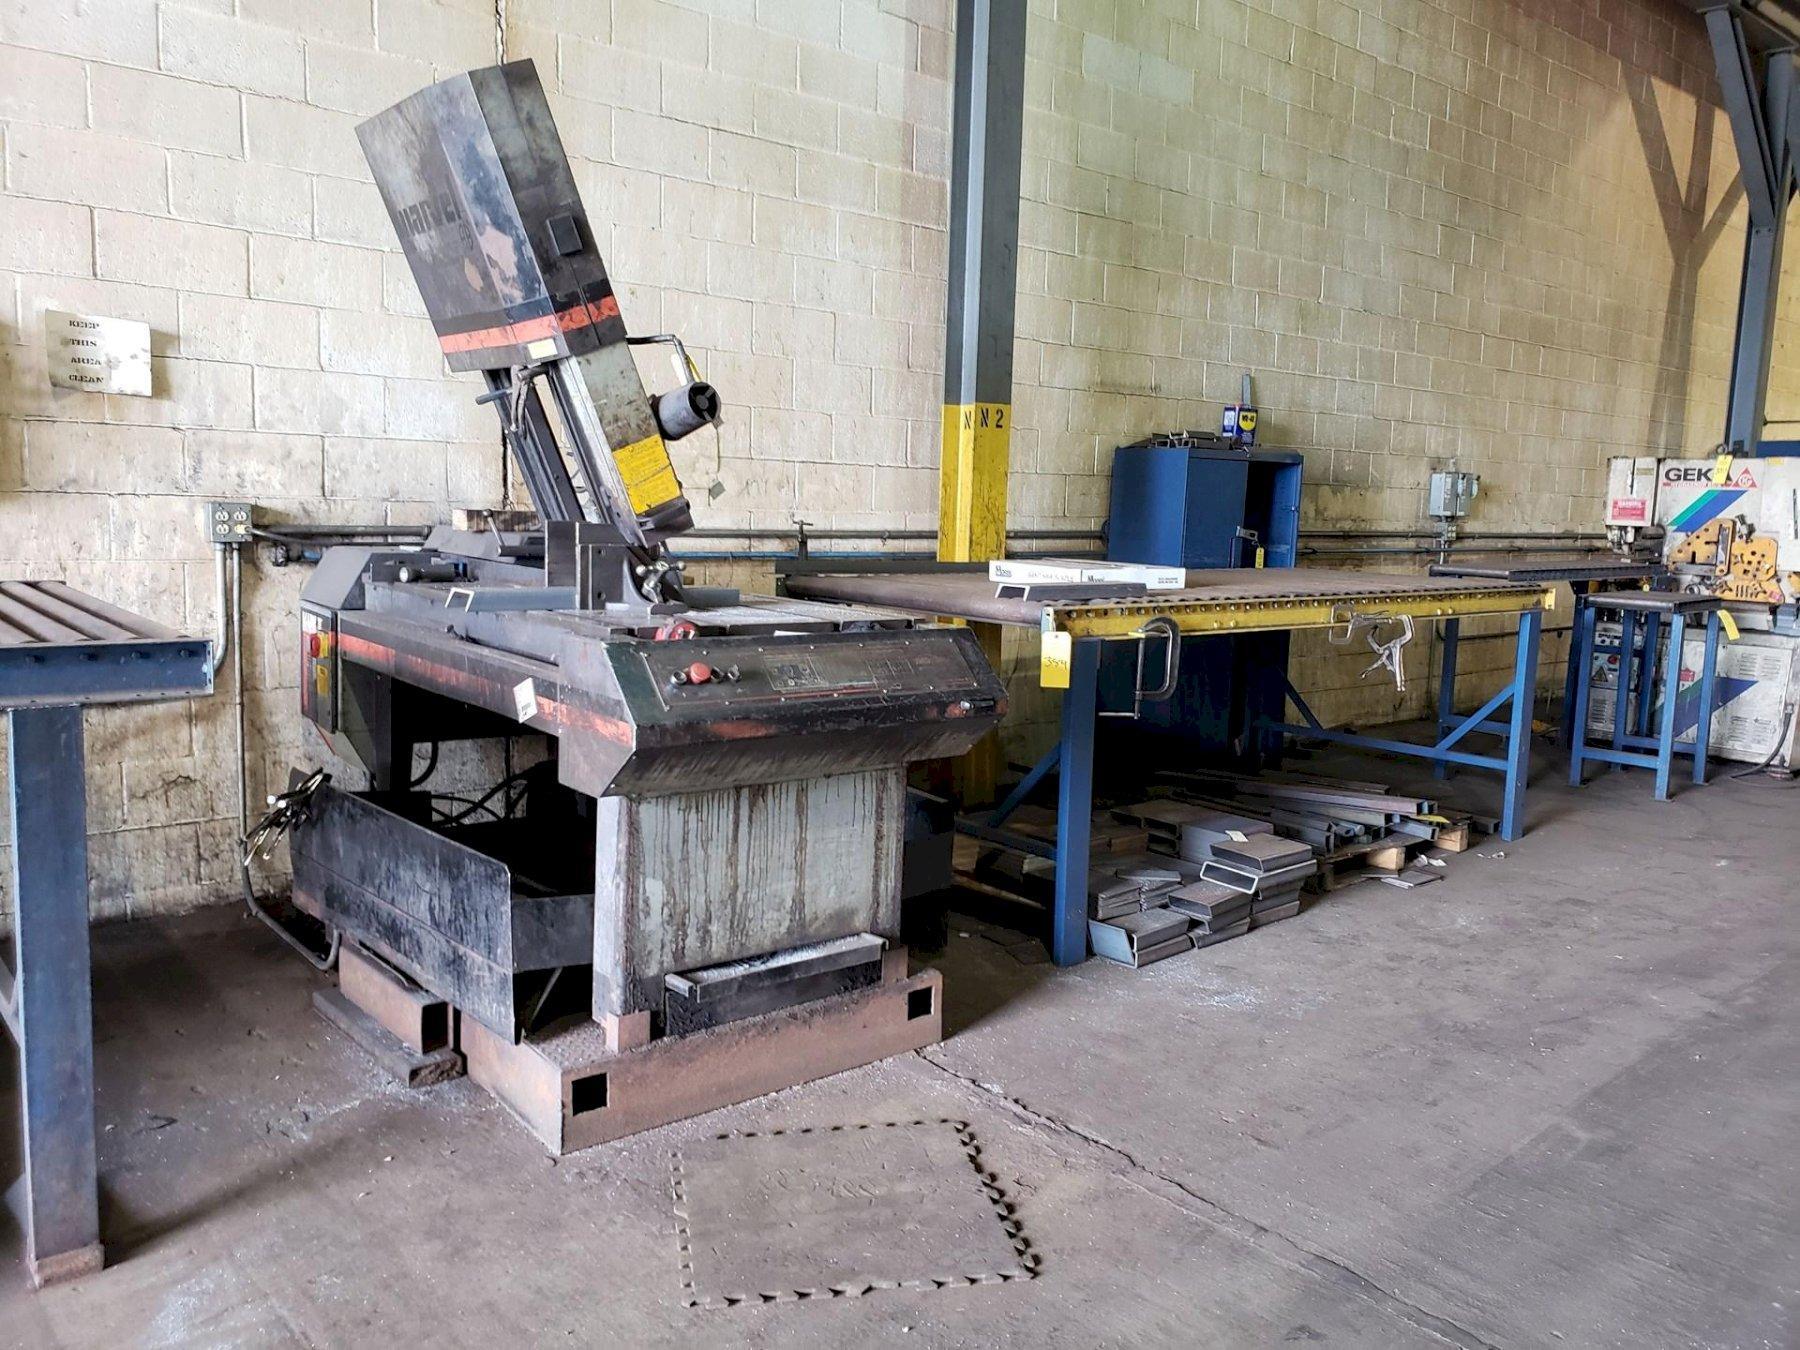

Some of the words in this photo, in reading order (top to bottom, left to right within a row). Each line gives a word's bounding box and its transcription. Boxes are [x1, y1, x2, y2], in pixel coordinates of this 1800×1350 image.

[69, 320, 100, 329] KEEP
[69, 338, 97, 347] THIS
[71, 356, 102, 366] AREA
[68, 374, 104, 384] CLEAN
[1664, 467, 1734, 482] GEK
